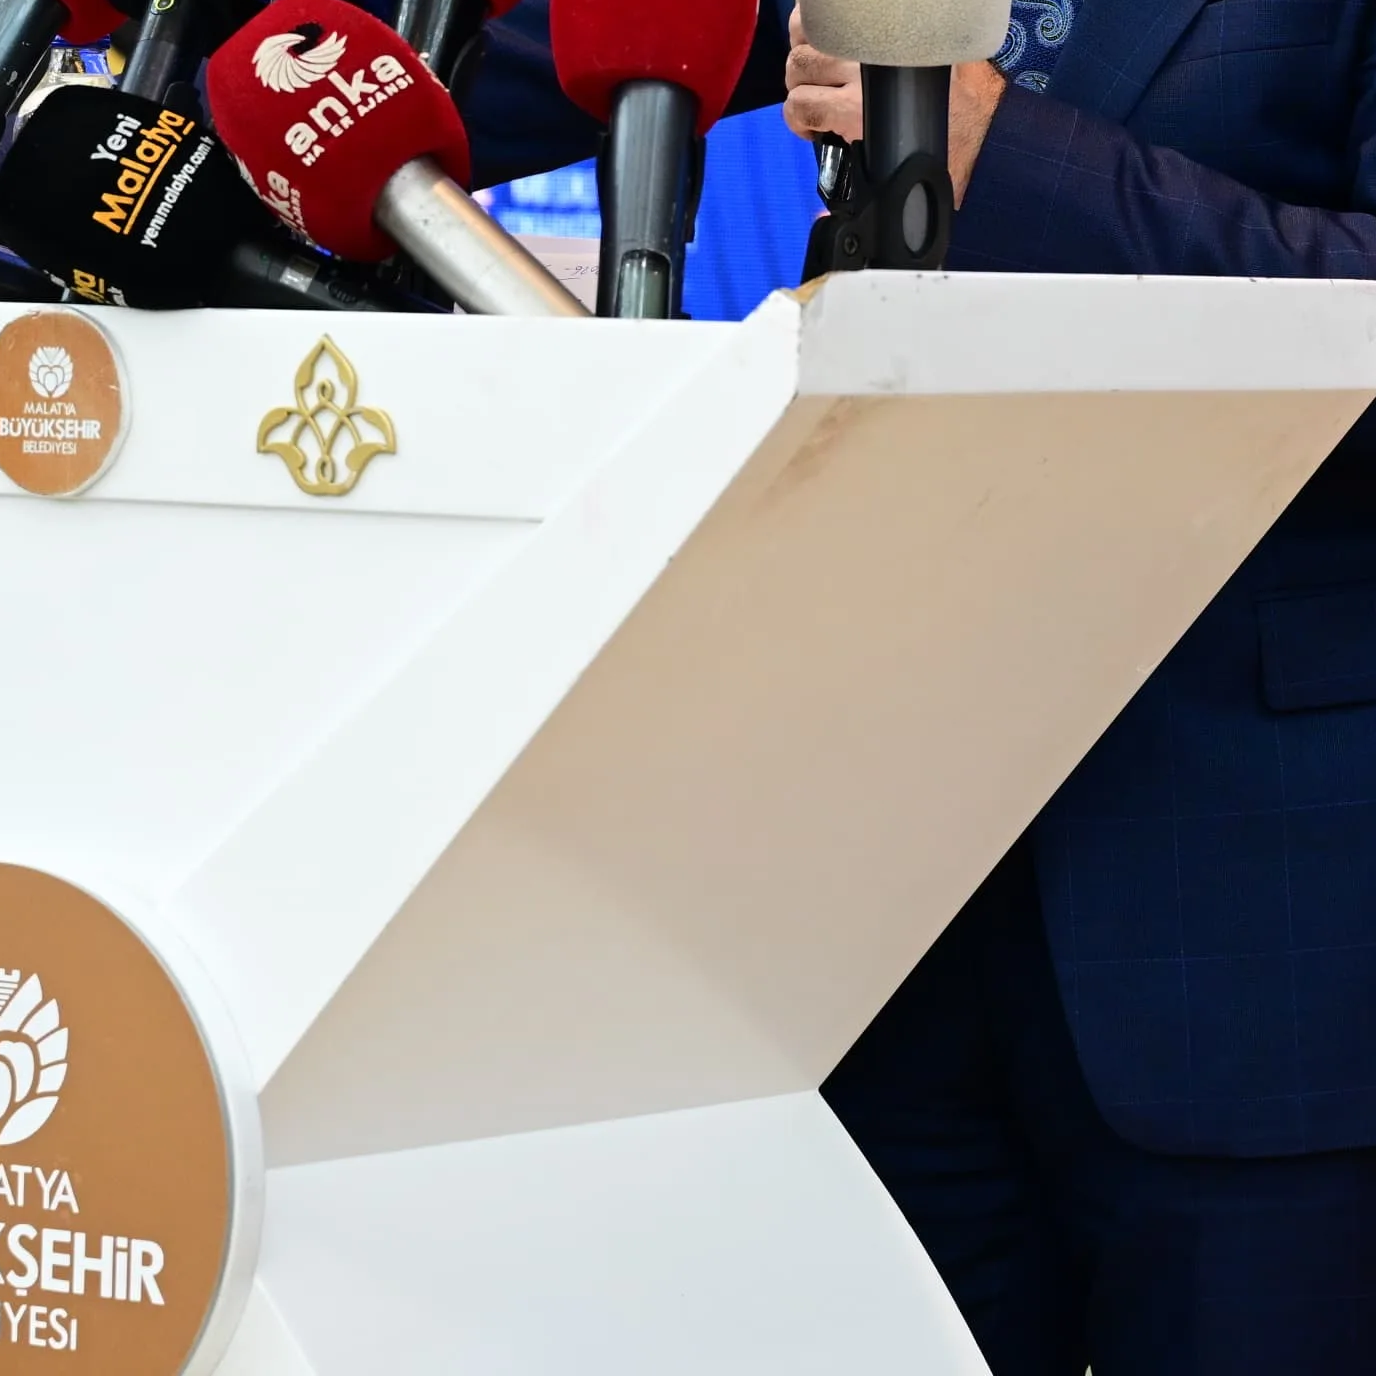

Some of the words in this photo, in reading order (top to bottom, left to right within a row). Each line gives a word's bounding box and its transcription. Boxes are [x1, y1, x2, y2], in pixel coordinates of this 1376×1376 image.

[285, 54, 406, 156] anka
[357, 73, 414, 117] AJANSI
[90, 112, 142, 162] Yeni
[92, 109, 185, 233] Malatya
[23, 401, 77, 416] MALATYA
